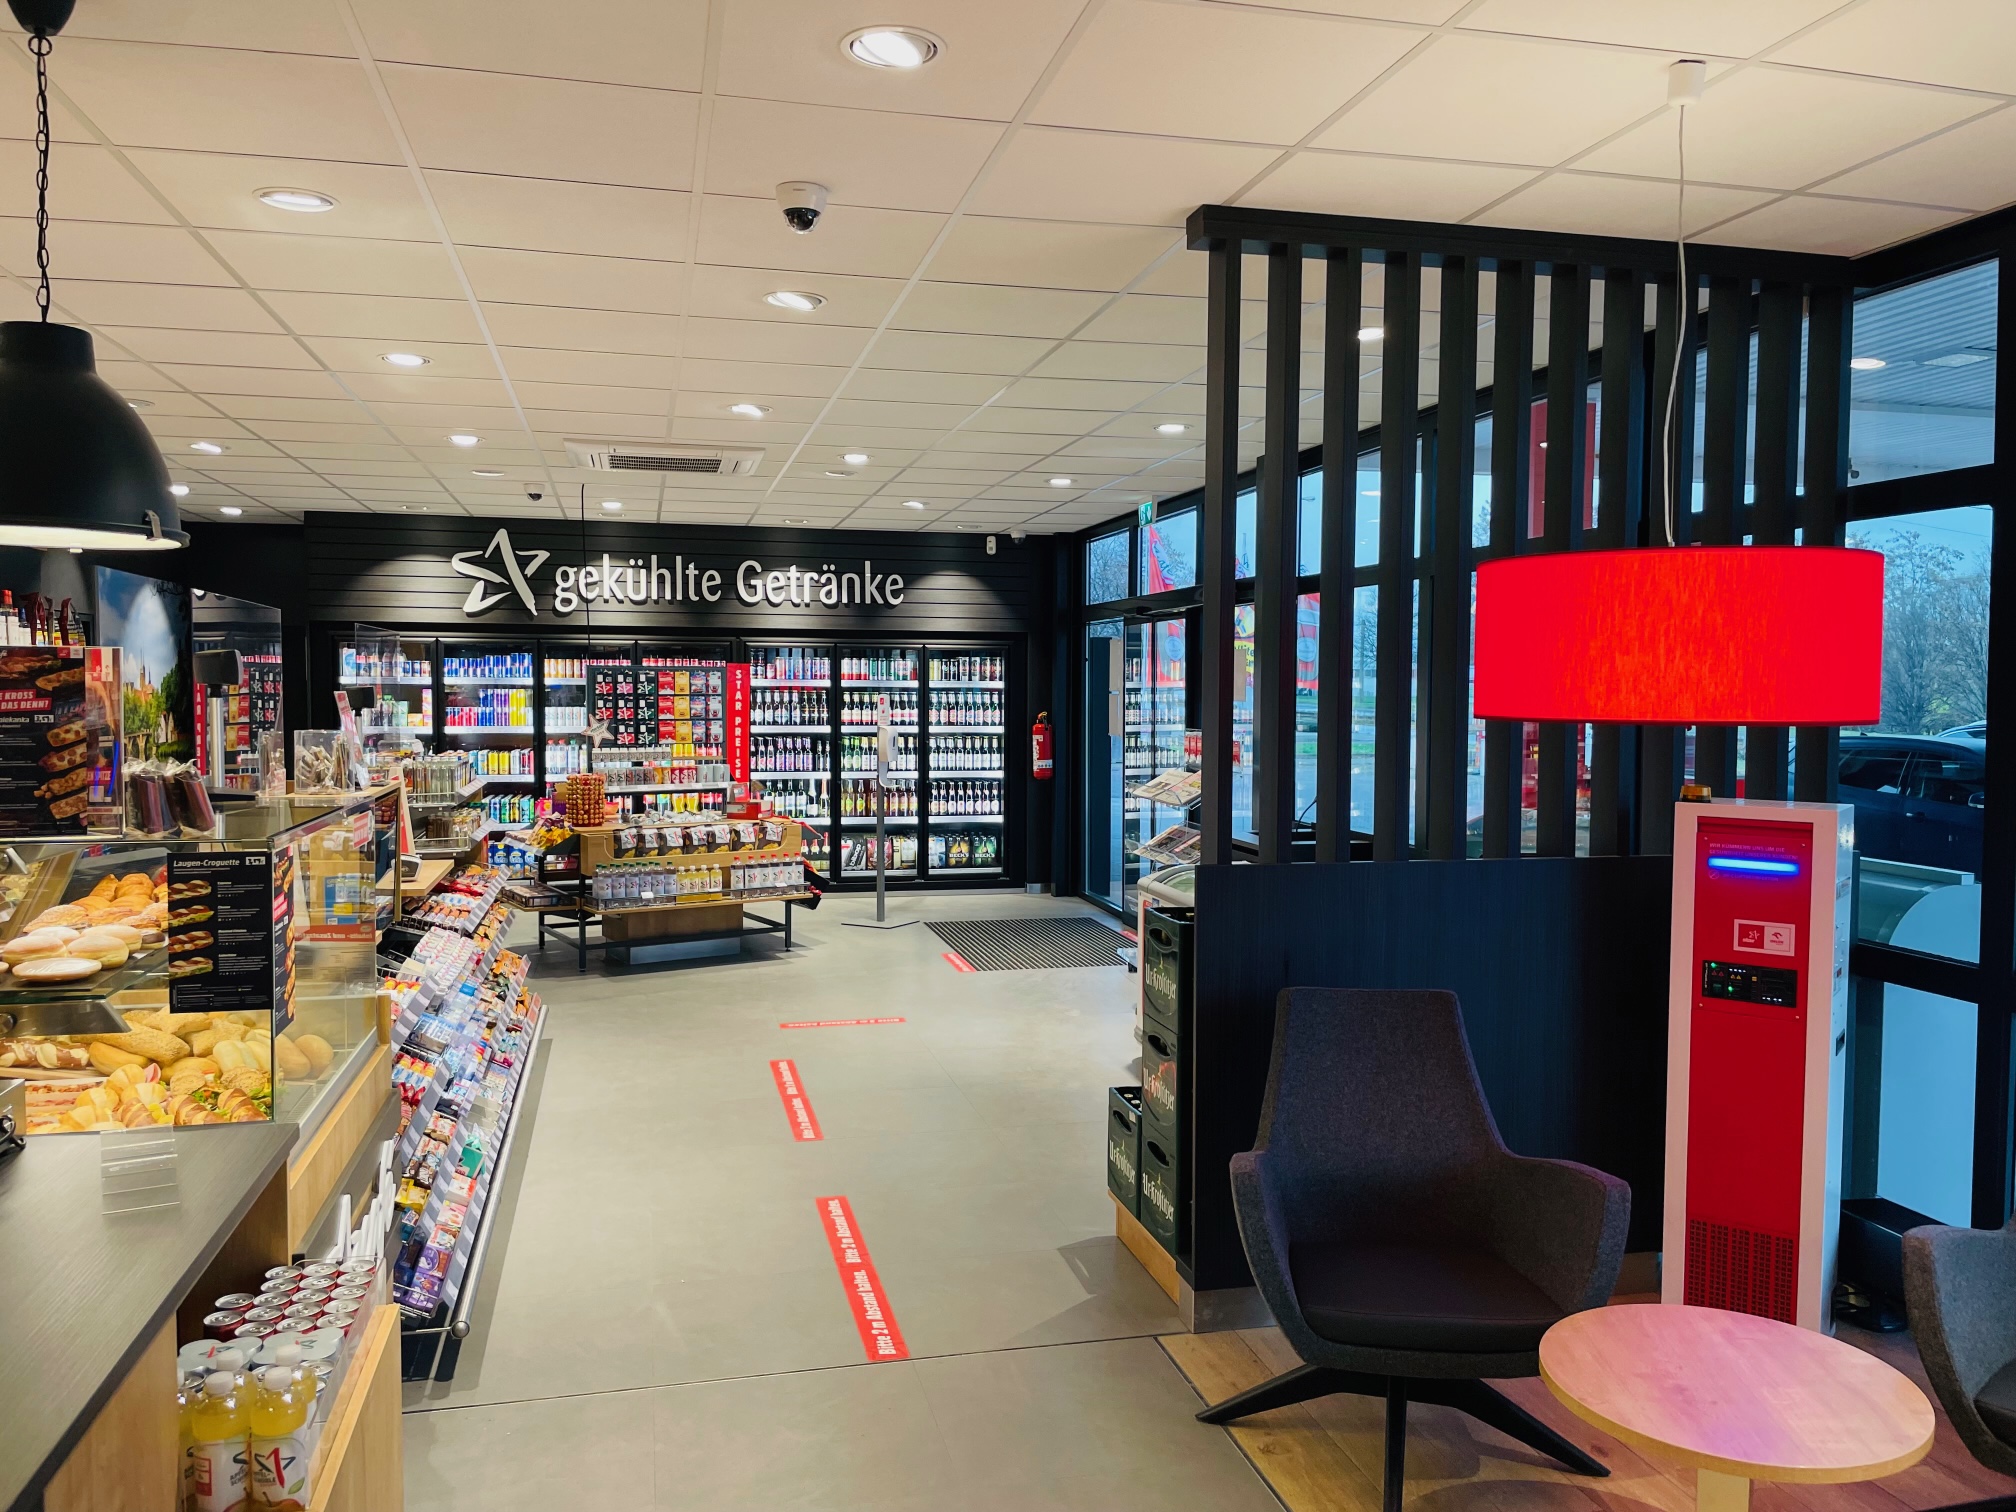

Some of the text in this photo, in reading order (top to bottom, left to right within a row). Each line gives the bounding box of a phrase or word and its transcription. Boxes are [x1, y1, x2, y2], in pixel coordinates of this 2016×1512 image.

[554, 553, 905, 613] gekühlte Getränke
[5, 691, 34, 700] KROSS
[1, 702, 19, 710] DAS
[734, 669, 742, 779] STAR PREISE
[827, 1199, 845, 1216] halten.
[830, 1215, 853, 1238] Abstand
[845, 1248, 862, 1263] Bitte
[853, 1269, 873, 1292] halten.
[857, 1292, 884, 1321] Abstand
[871, 1321, 887, 1329] m
[876, 1335, 897, 1355] Bitte
